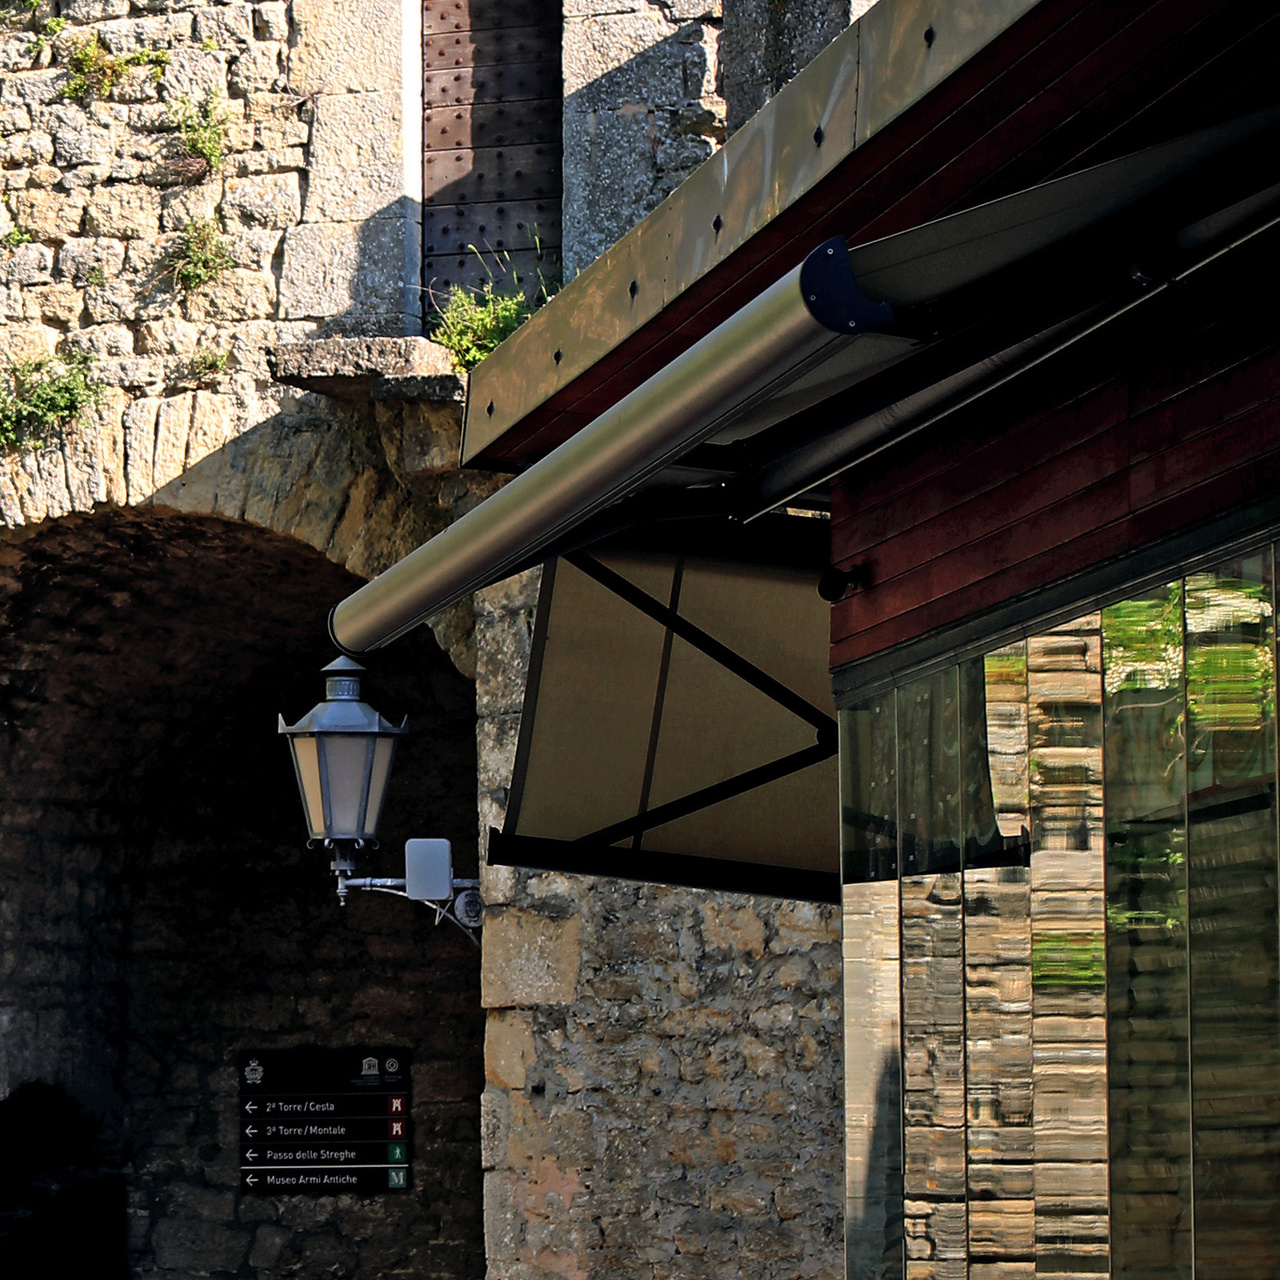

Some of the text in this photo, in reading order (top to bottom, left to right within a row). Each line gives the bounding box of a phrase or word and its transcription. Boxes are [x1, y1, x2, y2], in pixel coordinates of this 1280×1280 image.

[266, 1149, 356, 1162] Passo delle Streghe
[266, 1174, 358, 1185] Museo Armi Antiche
